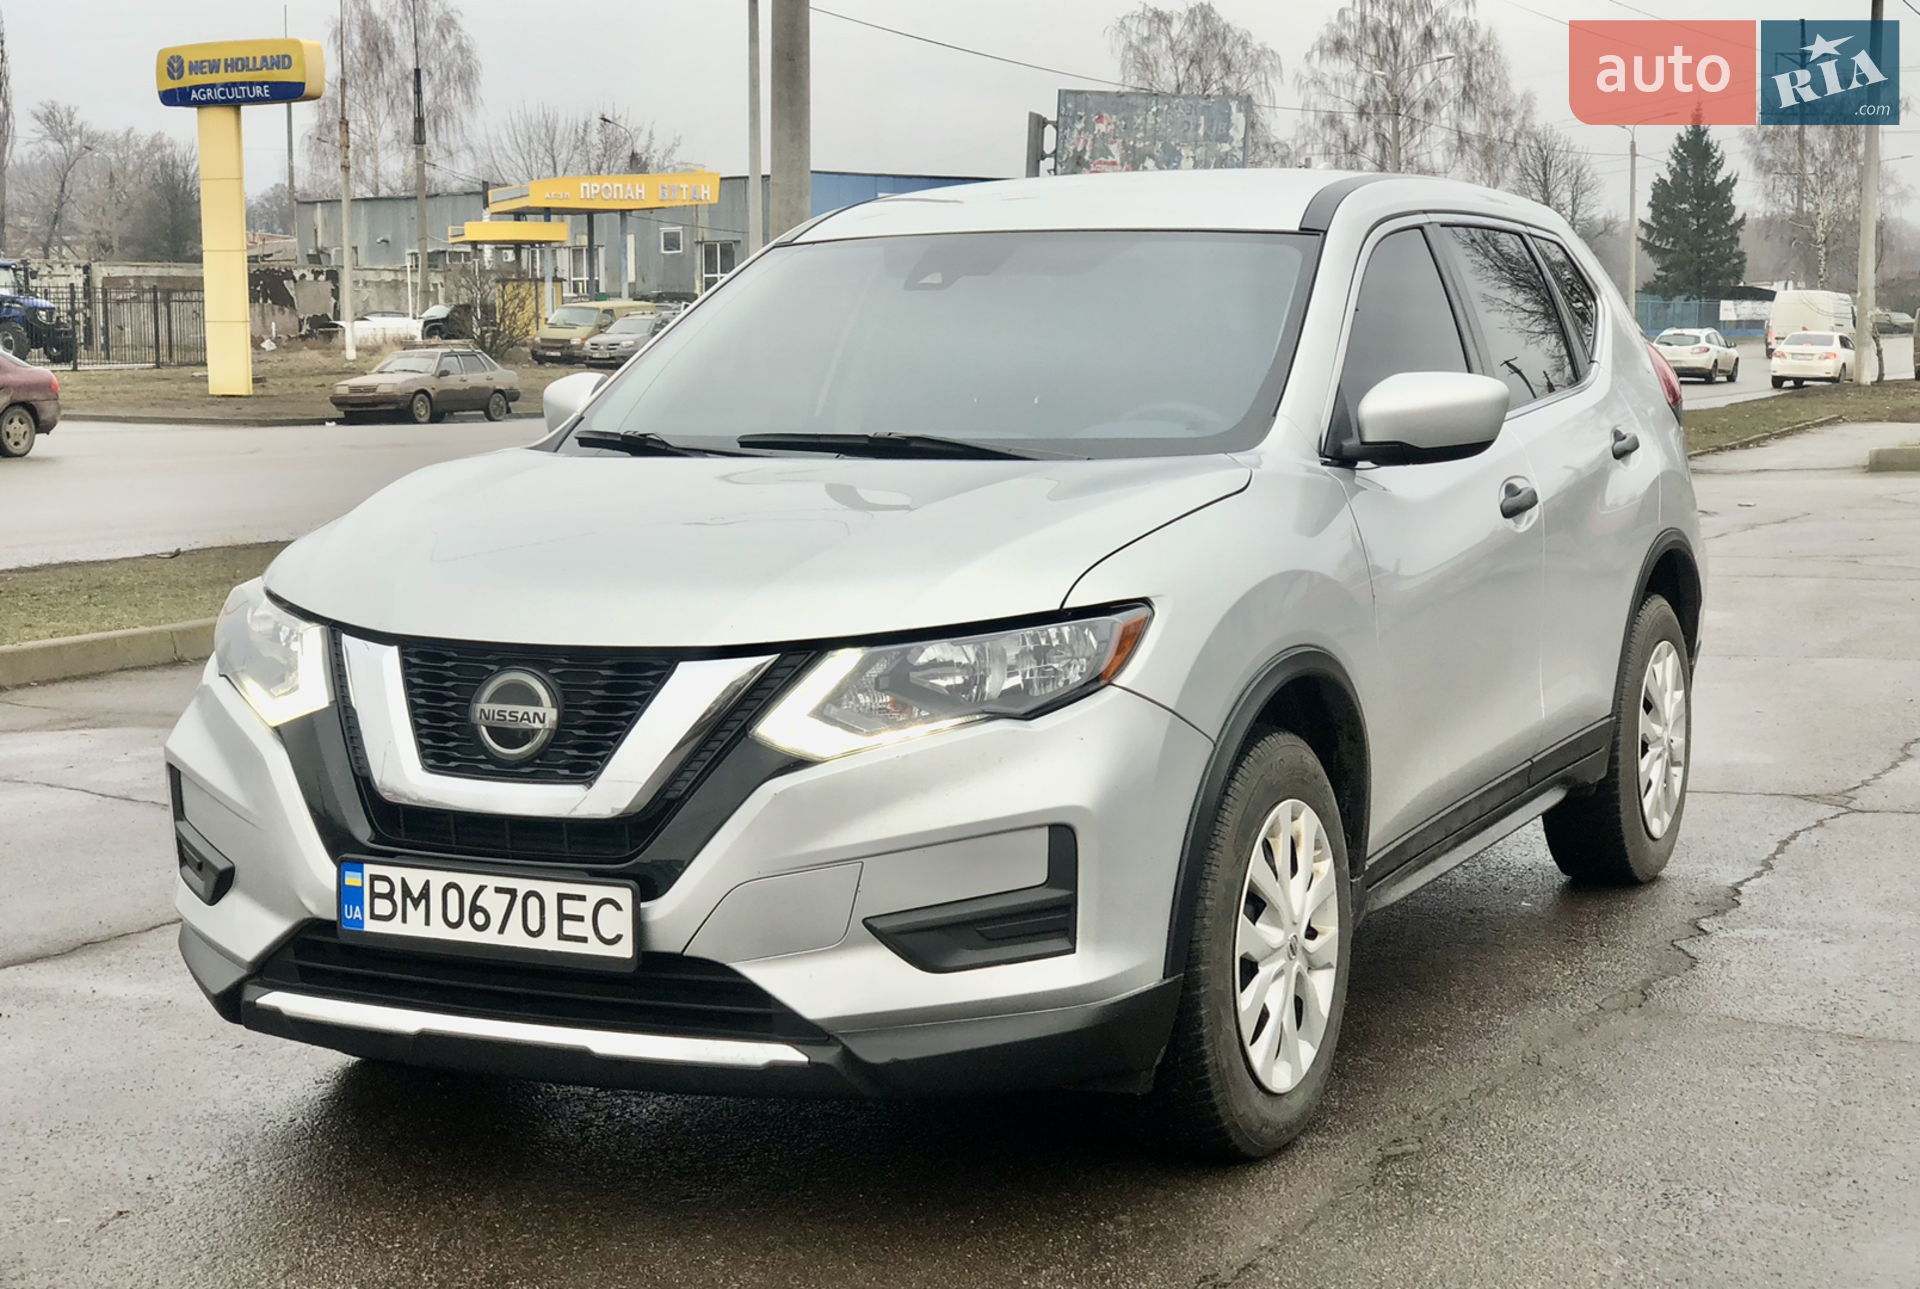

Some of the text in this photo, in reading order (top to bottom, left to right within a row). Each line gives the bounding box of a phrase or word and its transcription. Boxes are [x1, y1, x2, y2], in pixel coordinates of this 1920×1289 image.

[188, 54, 292, 75] NEW HOLLAND
[190, 85, 270, 101] AGRICULTURE
[580, 183, 645, 200] ПРОПАН
[659, 184, 711, 200] БУТАН
[479, 708, 546, 724] NISSAN
[344, 904, 363, 920] UA
